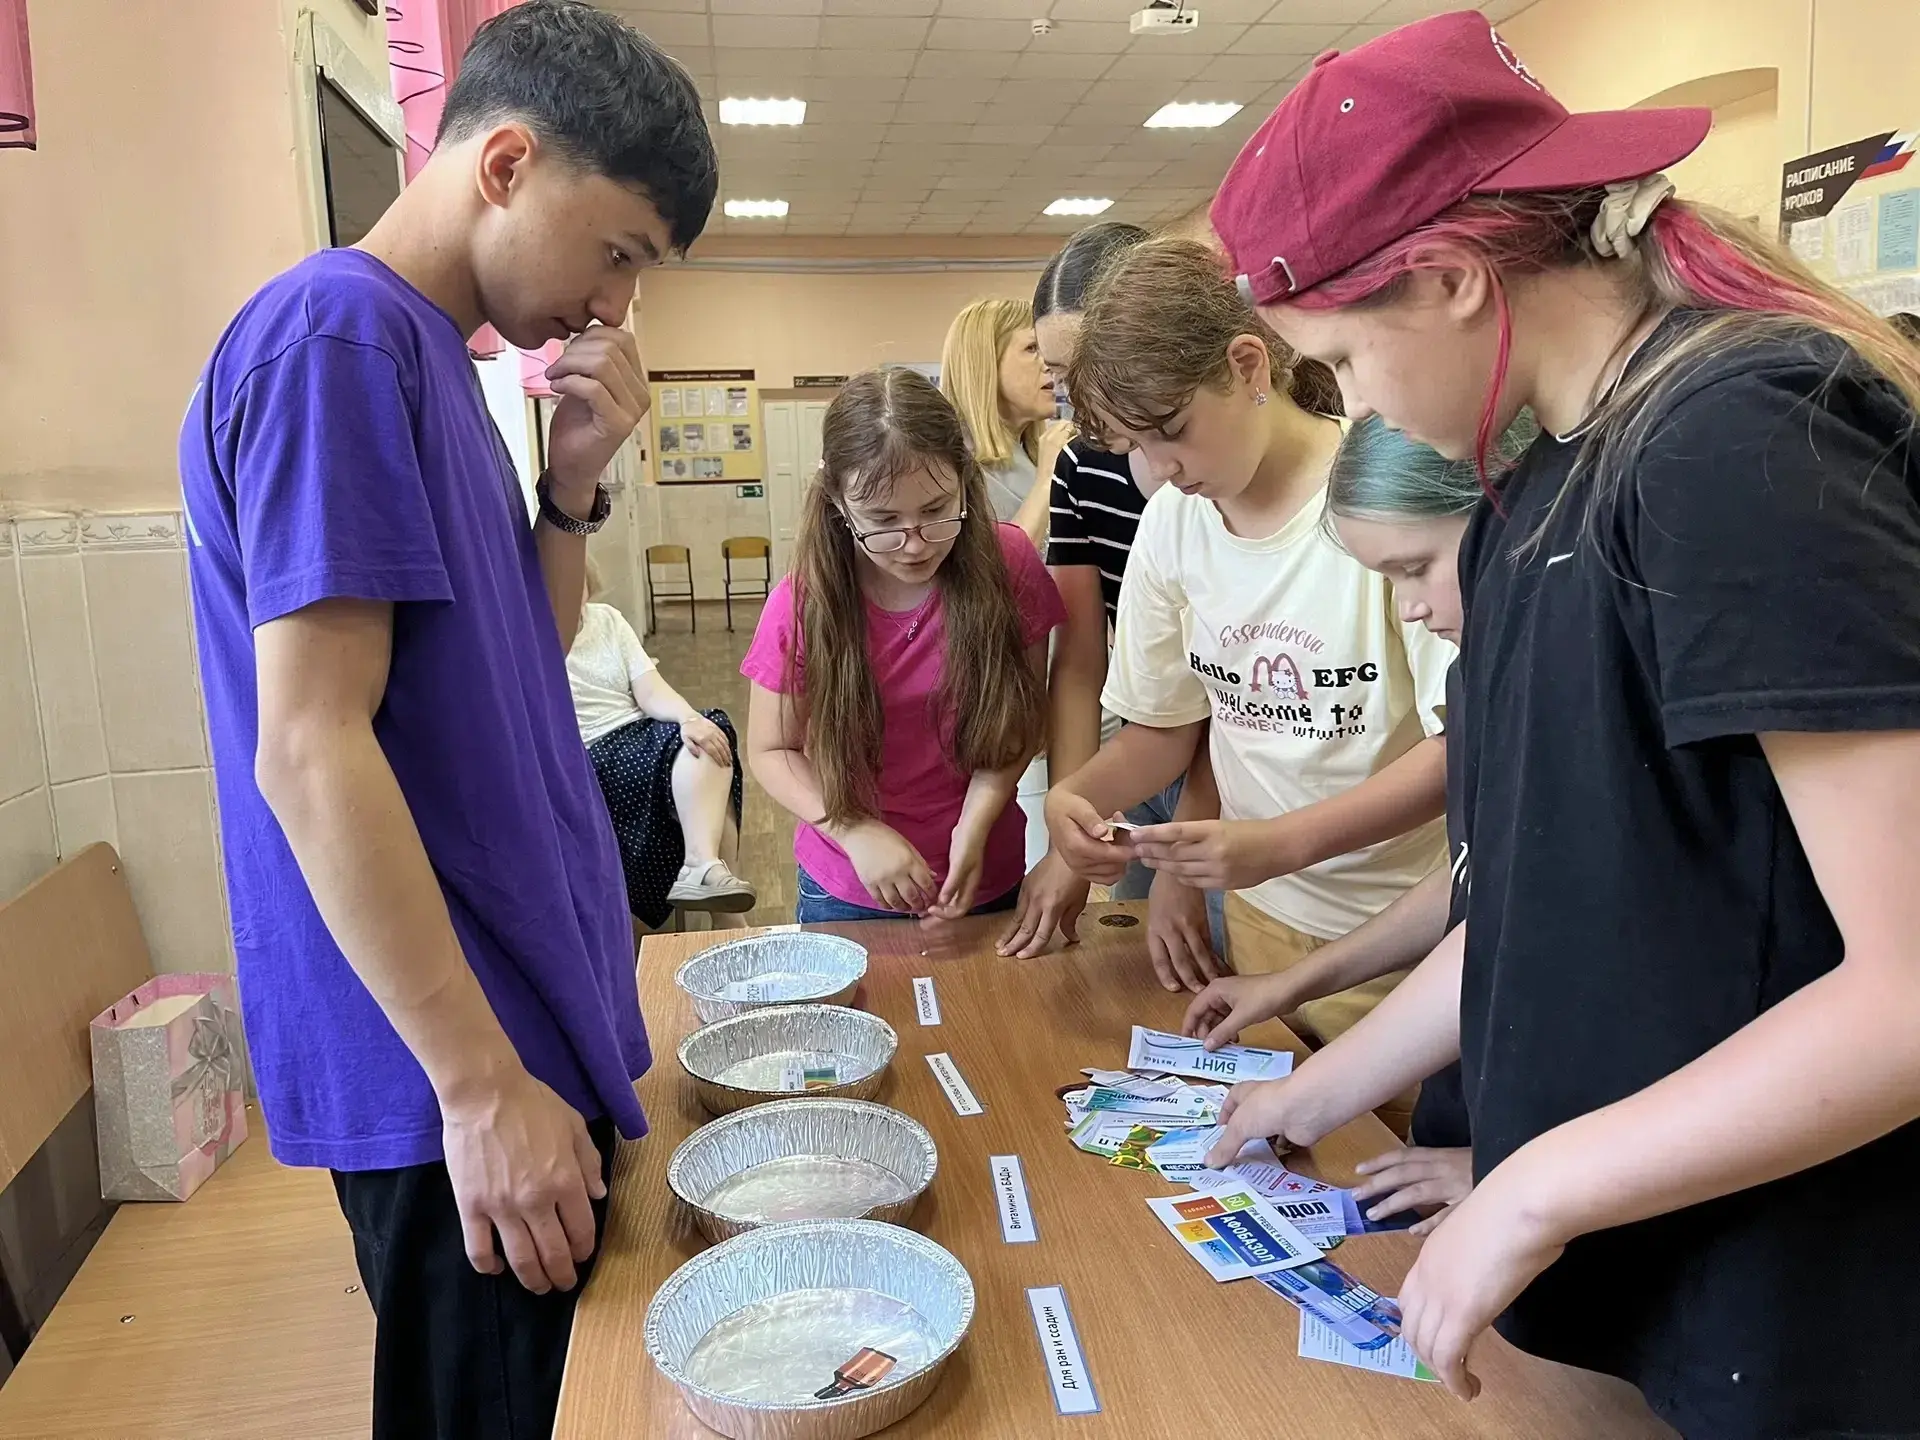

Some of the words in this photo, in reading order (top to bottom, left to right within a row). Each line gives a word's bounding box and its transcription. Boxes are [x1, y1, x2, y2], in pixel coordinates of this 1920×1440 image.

[1786, 156, 1855, 188] РАСПИСАНИЕ
[1785, 188, 1824, 211] УРОКОВ
[1220, 619, 1326, 655] Essenderova
[1189, 652, 1242, 685] Hello
[1312, 662, 1379, 688] EFG
[1330, 703, 1363, 725] to
[1192, 1056, 1238, 1075] БИНТ
[1000, 1166, 1013, 1186] БАДы
[1006, 1193, 1022, 1229] Витамины
[1227, 1196, 1246, 1207] 60
[1273, 1201, 1331, 1219] ИДОЛ
[1220, 1215, 1276, 1262] АФОБАЗОЛ
[1043, 1305, 1061, 1338] ссадин
[1055, 1348, 1073, 1367] ран
[1062, 1369, 1079, 1390] Для
